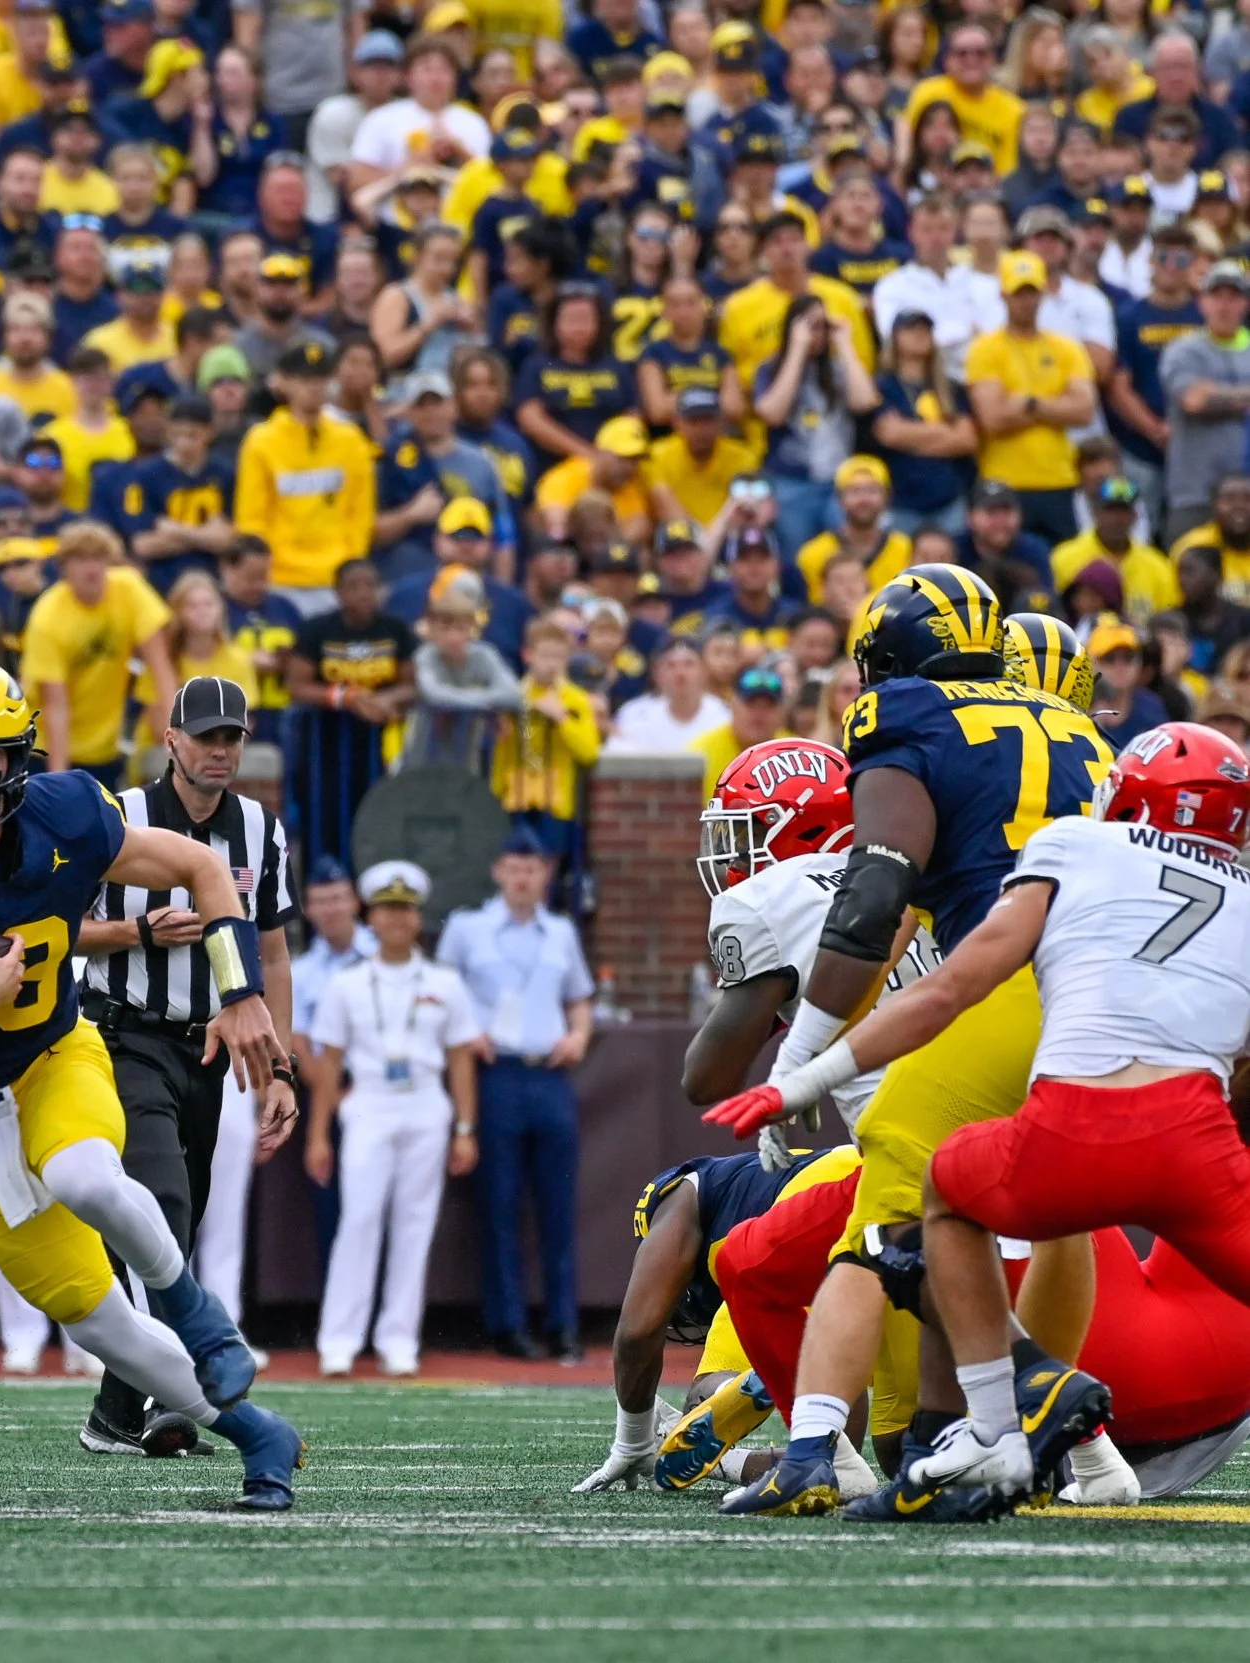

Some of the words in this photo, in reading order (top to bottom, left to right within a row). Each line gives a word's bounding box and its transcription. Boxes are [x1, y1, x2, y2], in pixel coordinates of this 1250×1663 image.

[941, 638, 956, 650] 73
[751, 750, 828, 798] UNLV
[1228, 807, 1244, 833] 7
[1129, 827, 1250, 884] WOODAR
[1131, 863, 1226, 965] 7
